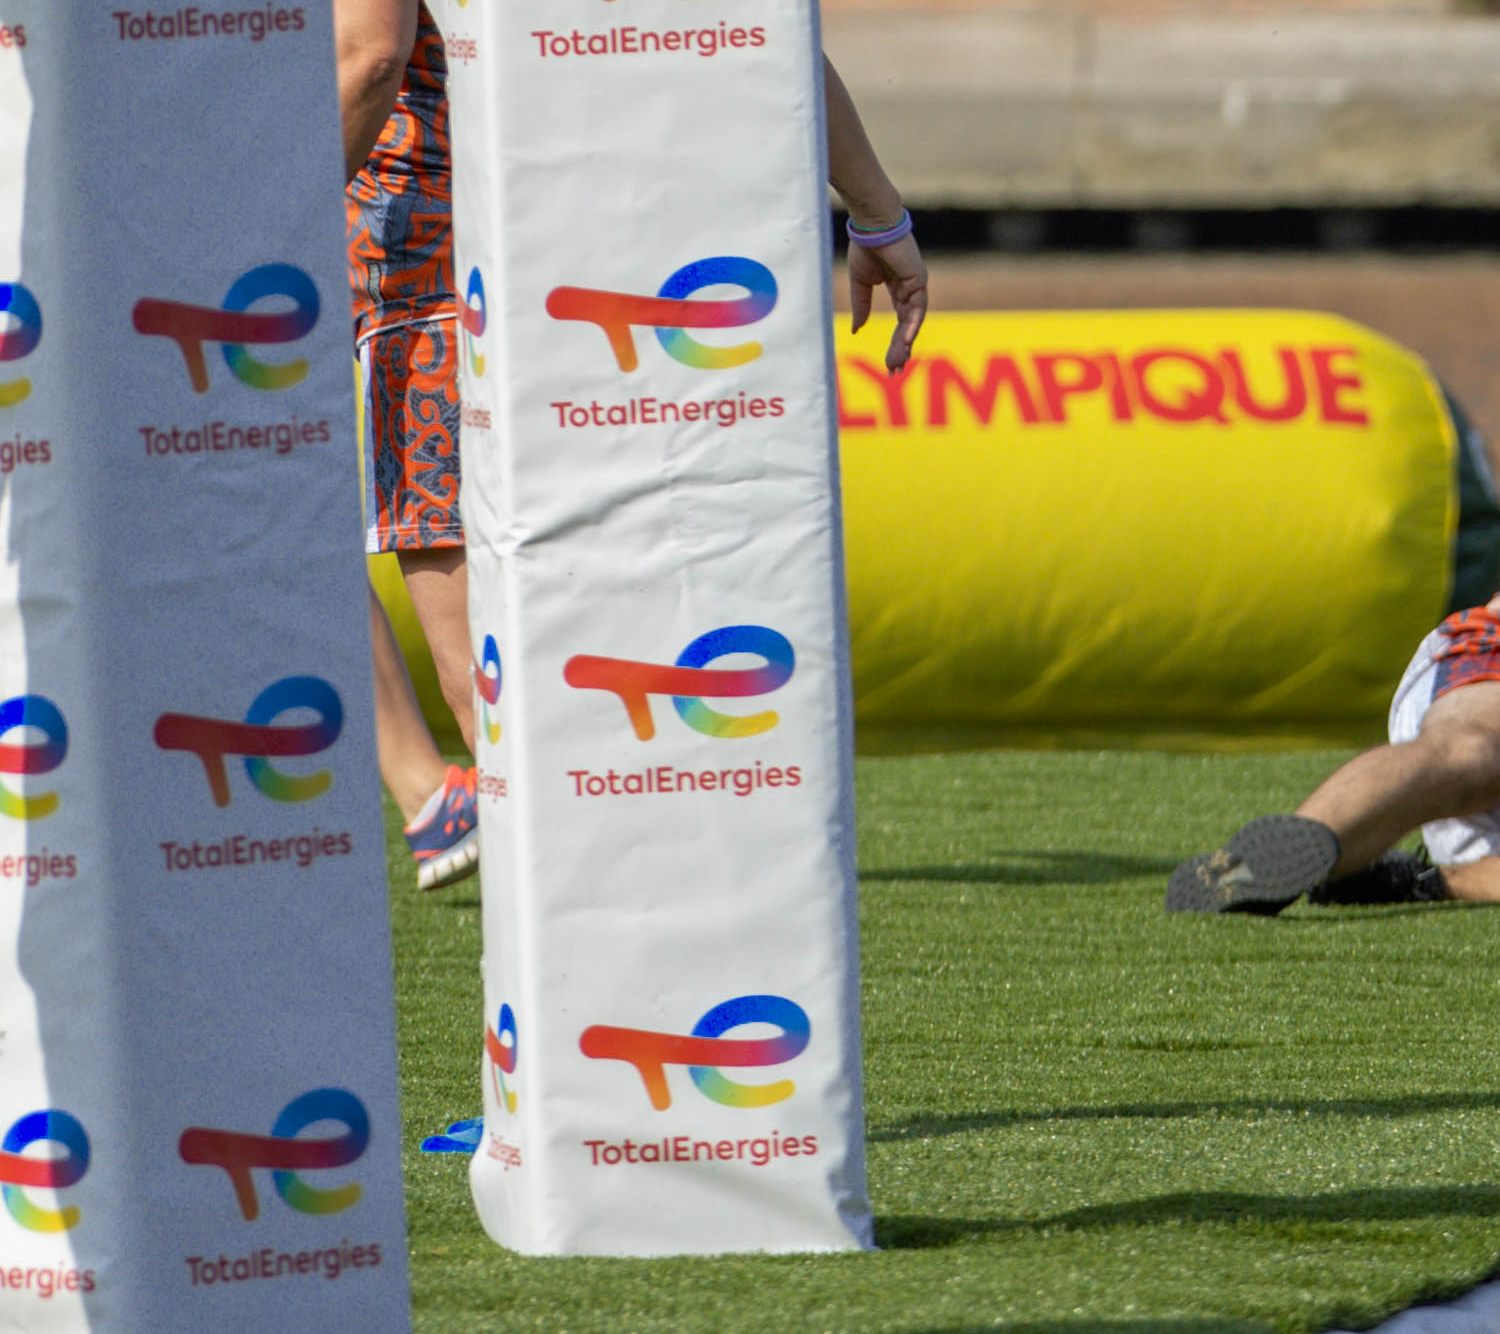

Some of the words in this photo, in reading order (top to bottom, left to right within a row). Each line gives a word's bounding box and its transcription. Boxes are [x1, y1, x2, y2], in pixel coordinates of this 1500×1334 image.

[111, 3, 305, 43] TotalEnergies
[531, 20, 766, 58] TotalEnergies
[550, 391, 785, 428] TotalEnergies
[138, 416, 331, 456] TotalEnergies
[567, 760, 801, 798] TotalEnergies
[159, 828, 353, 871] TotalEnergies
[583, 1130, 818, 1167] TotalEnergies
[185, 1240, 382, 1286] TotalEnergies
